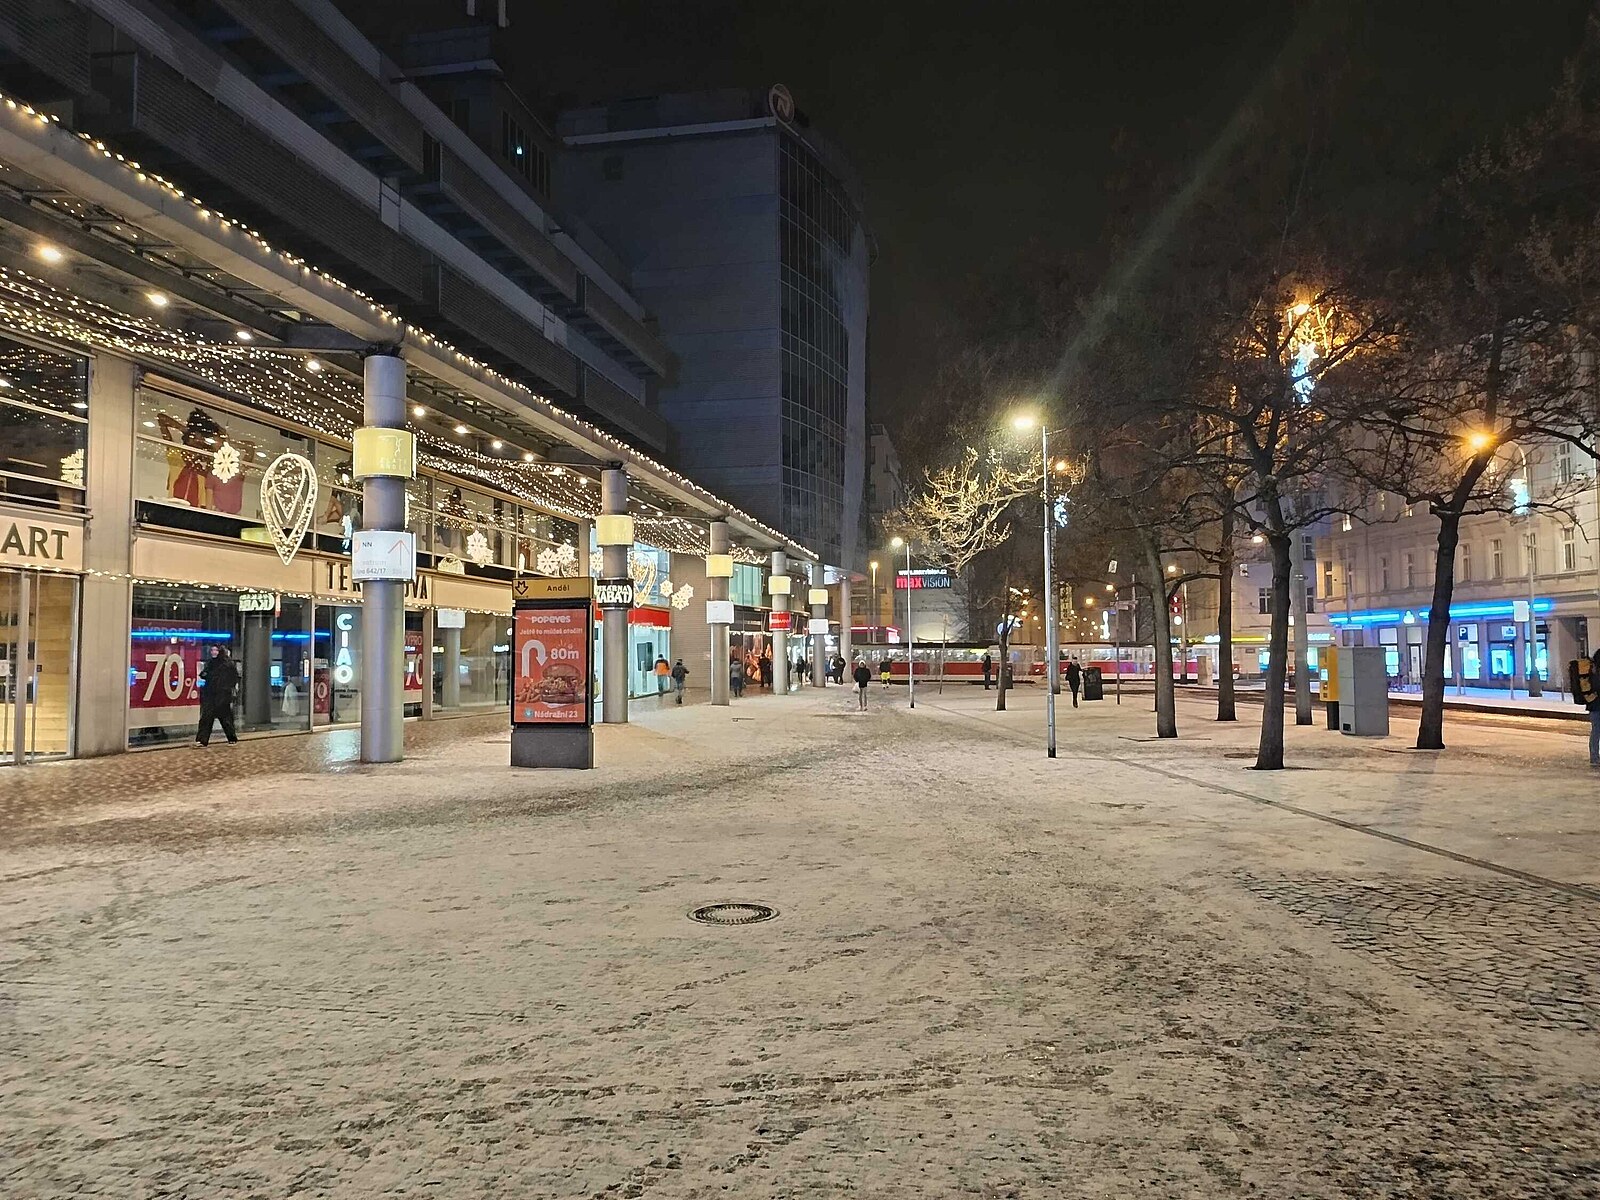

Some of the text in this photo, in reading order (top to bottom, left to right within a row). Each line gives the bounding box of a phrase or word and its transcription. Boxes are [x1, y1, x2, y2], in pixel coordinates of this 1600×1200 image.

[0, 522, 69, 560] ART
[335, 613, 353, 684] CIAO
[551, 648, 580, 659] 80m
[568, 710, 578, 718] 23
